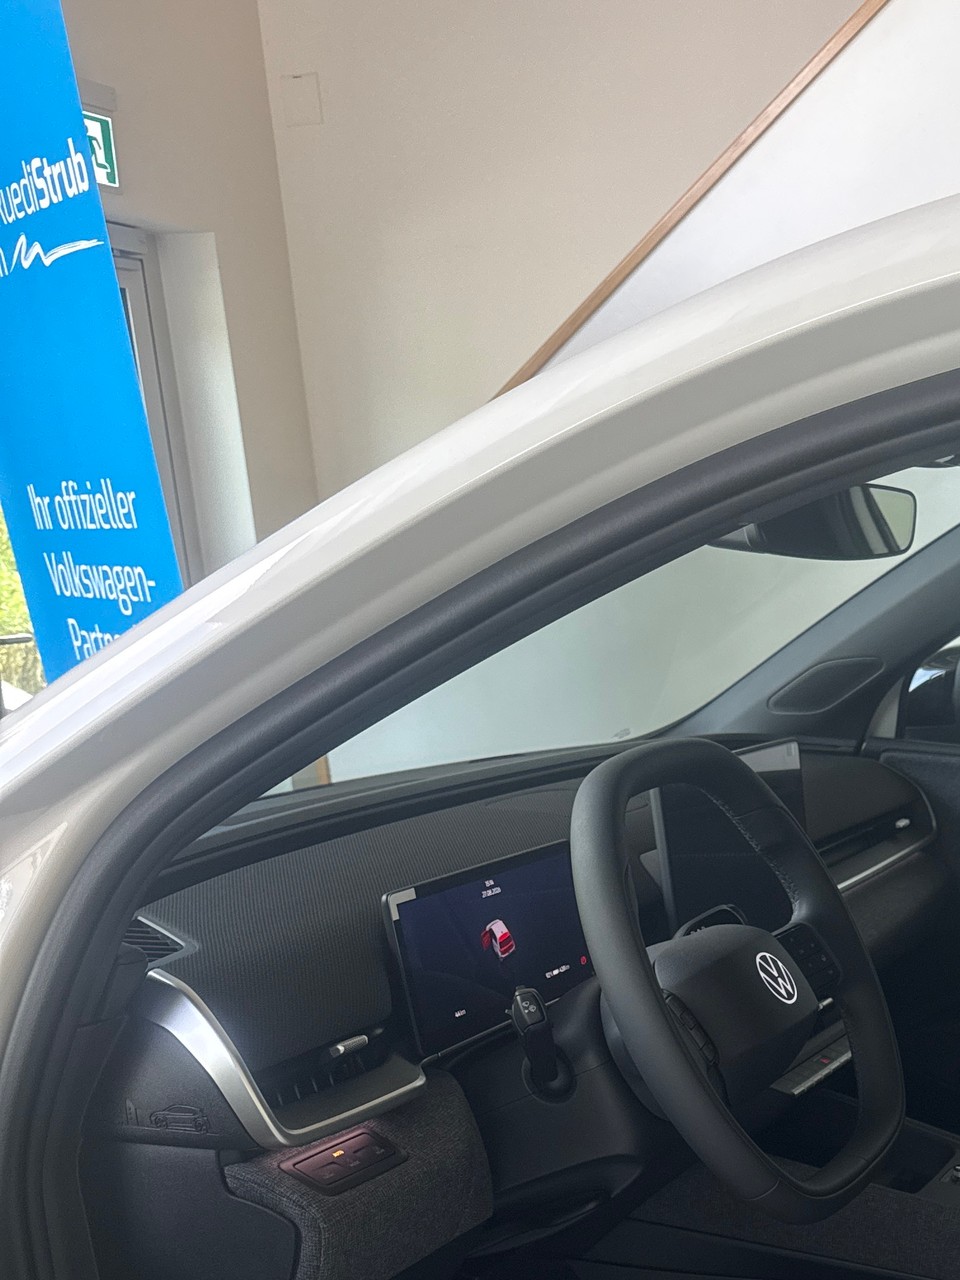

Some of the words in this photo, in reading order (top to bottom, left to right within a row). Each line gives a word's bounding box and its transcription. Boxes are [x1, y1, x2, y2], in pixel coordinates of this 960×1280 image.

[27, 483, 54, 530] Ihr
[54, 477, 138, 530] offizieller
[43, 551, 156, 616] Volkswagen-
[67, 617, 135, 660] Partn
